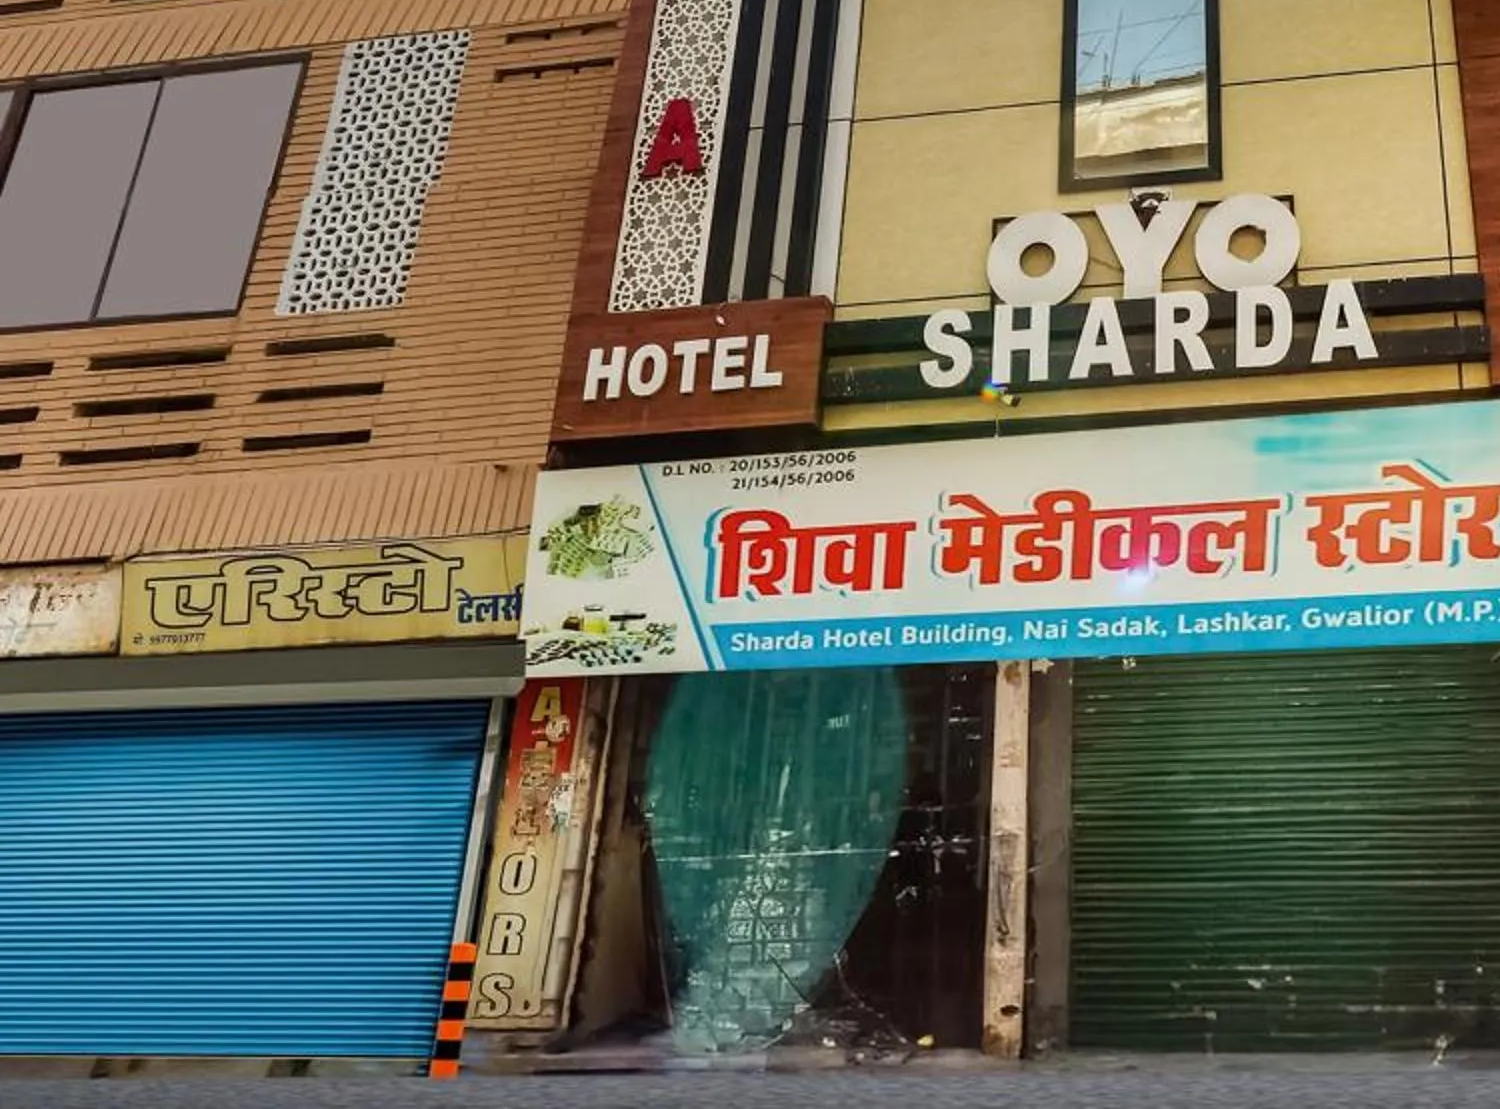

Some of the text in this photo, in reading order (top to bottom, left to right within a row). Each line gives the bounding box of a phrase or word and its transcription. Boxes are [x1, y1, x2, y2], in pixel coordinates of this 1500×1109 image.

[987, 193, 1301, 307] OYO
[583, 334, 784, 403] HOTEL
[919, 279, 1378, 390] SHARDA
[730, 451, 856, 472] 20/153/56/2006
[732, 469, 855, 490] 21/154/56/2006
[716, 510, 916, 599] शिवा
[938, 489, 1280, 588] मेडीकल
[145, 544, 464, 628] एरिस्टो
[731, 628, 813, 653] Sharda
[823, 625, 892, 649] Hotel
[901, 621, 1013, 649] Building,
[1023, 619, 1069, 641] Nai
[1077, 616, 1167, 642] Sadak,
[1177, 610, 1292, 635] Lashkar,
[1302, 604, 1414, 629] Gwalior
